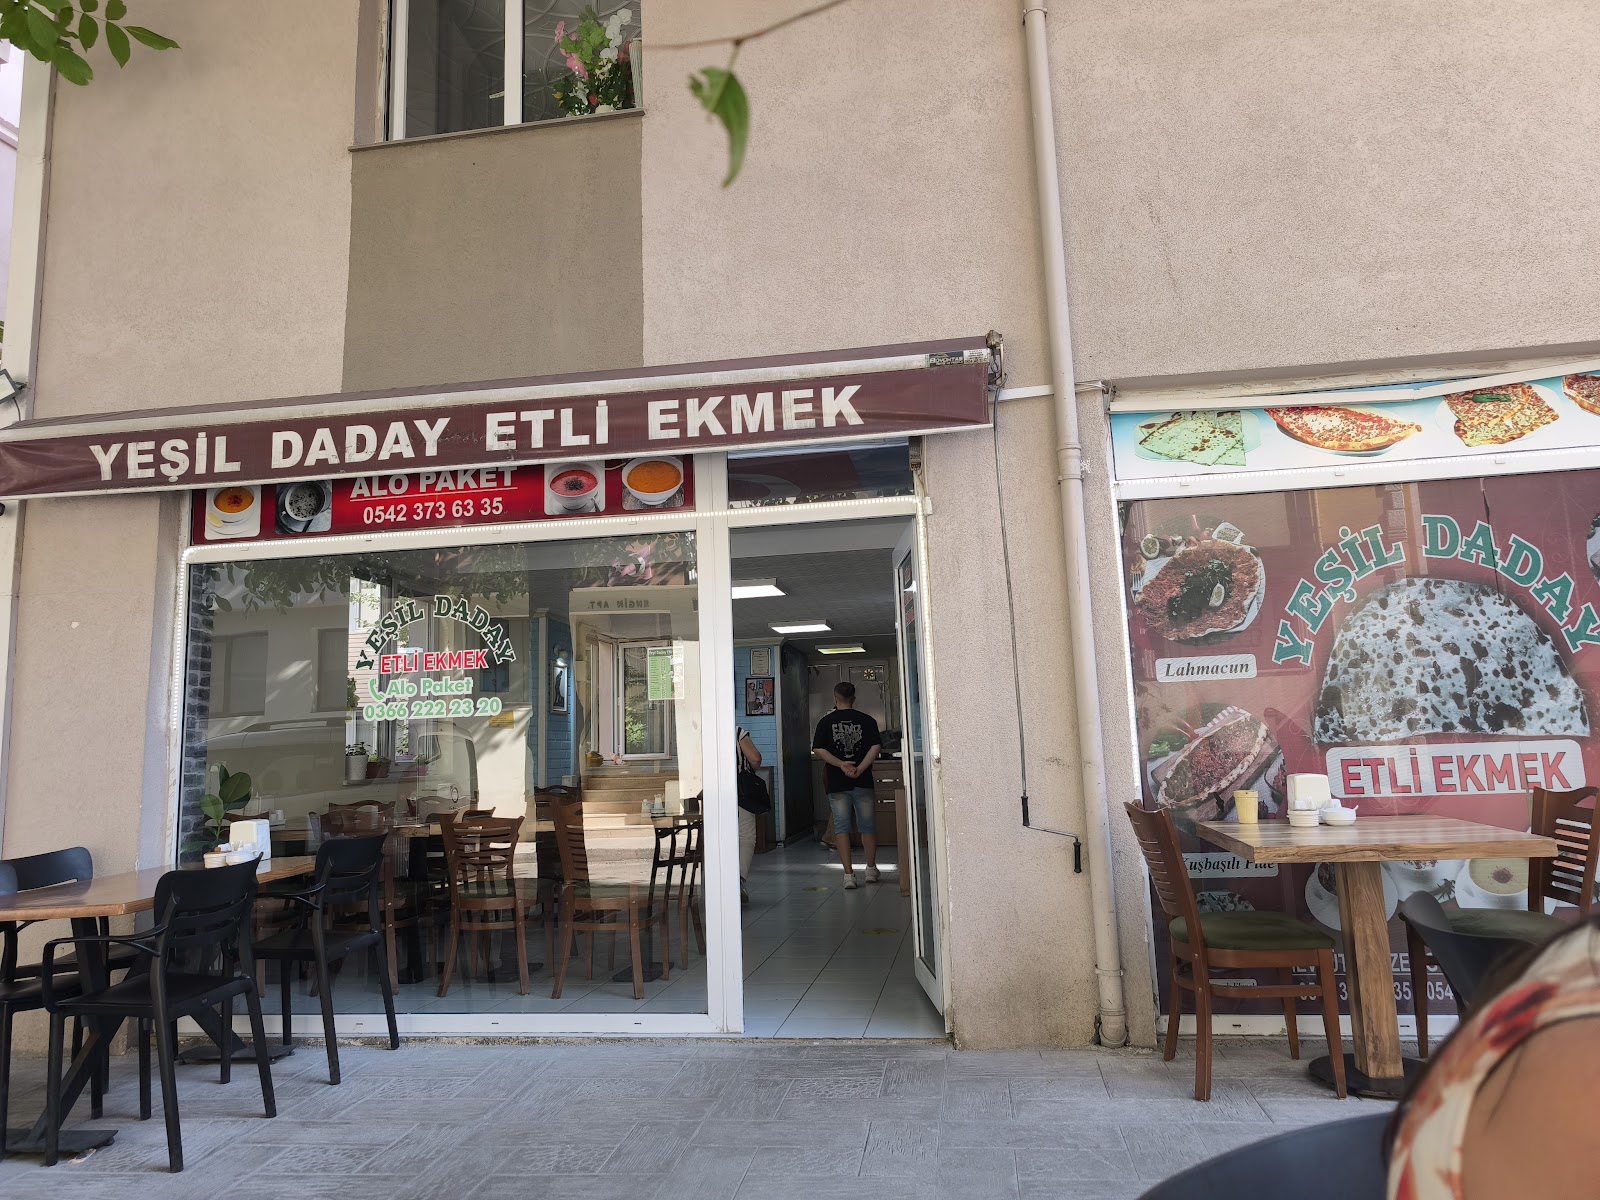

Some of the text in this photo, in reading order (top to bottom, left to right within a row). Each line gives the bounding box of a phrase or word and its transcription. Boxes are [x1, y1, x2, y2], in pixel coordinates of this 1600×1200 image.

[89, 385, 865, 482] YEŞİL DADAY ETLİ EKMEK
[351, 466, 517, 498] ALO PAKET
[363, 497, 503, 524] 0542 373 63 35
[1272, 514, 1600, 666] YEŞİL DADAY
[355, 595, 517, 671] YEŞİL DADAY
[380, 649, 489, 674] ETLİ EKMEK
[1164, 660, 1250, 679] Lahmacun
[386, 677, 474, 697] Alo Paket
[363, 697, 502, 720] 0366 222 23 20
[1340, 747, 1572, 795] ETLİ EKMEK
